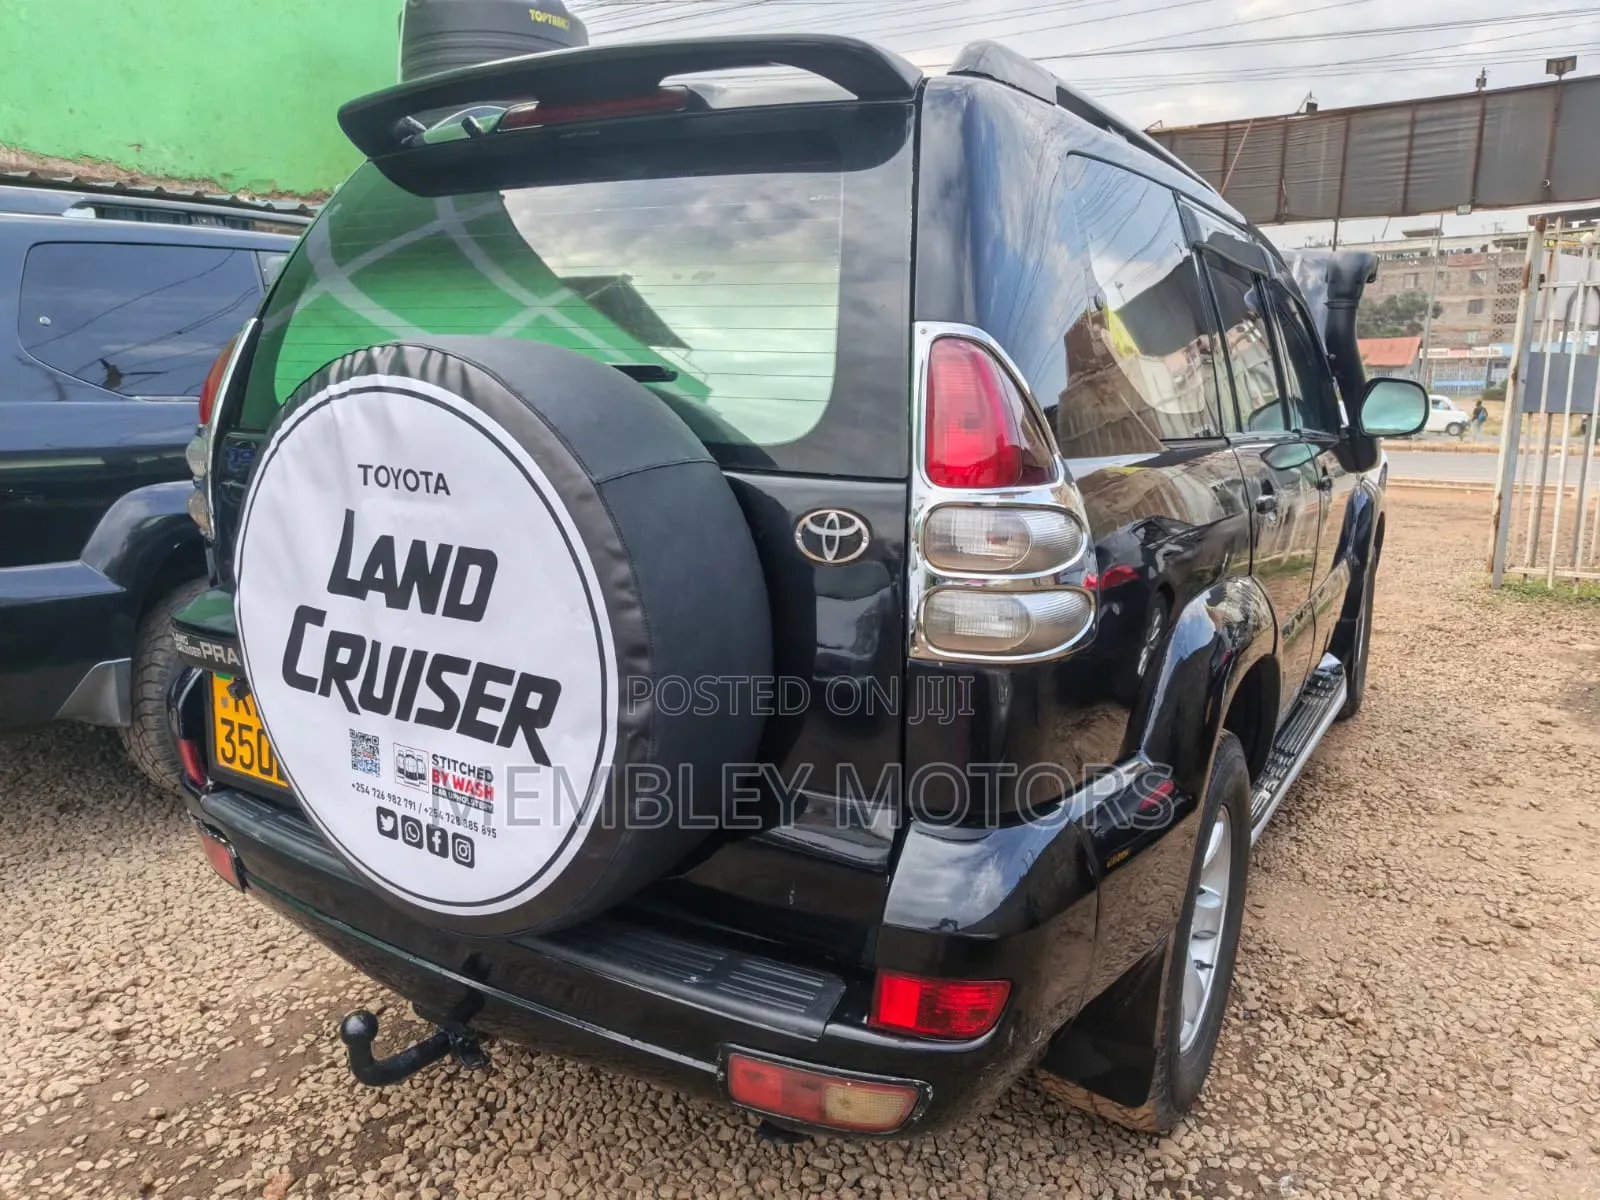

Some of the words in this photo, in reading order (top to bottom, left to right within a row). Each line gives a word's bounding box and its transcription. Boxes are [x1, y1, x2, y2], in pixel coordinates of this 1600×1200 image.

[357, 464, 451, 496] TOYOTA
[327, 508, 498, 622] LAND
[281, 605, 562, 767] CRUISER
[431, 753, 494, 783] STITCHED
[351, 782, 370, 795] +254
[371, 787, 385, 801] 726
[387, 792, 402, 807] 982
[403, 798, 416, 812] 791
[432, 768, 449, 787] BY
[451, 774, 495, 801] WASH
